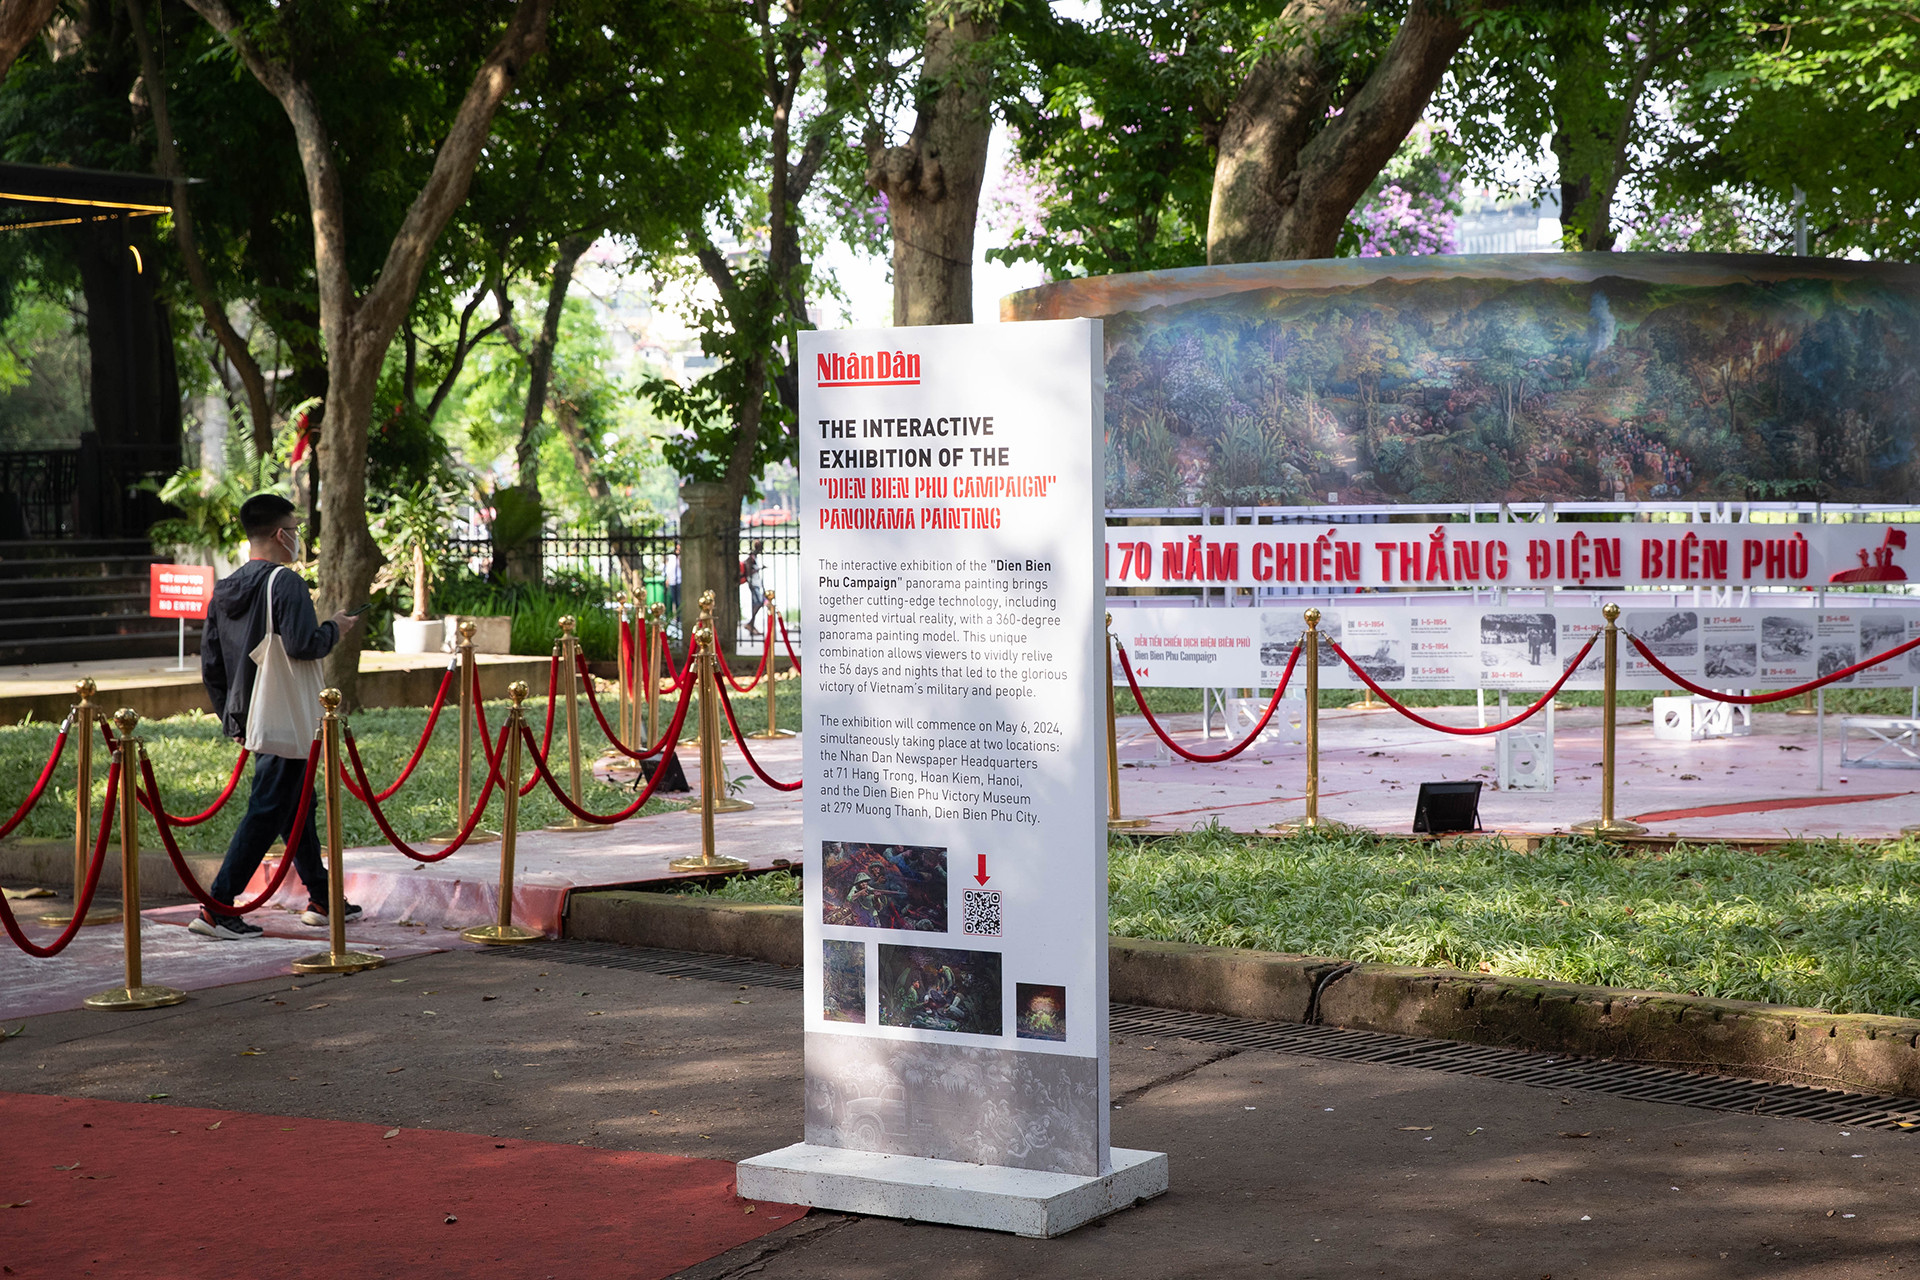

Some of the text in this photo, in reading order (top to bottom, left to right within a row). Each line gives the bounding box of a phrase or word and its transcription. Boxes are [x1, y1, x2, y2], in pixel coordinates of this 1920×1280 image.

[818, 351, 920, 380] Nhân Dân
[819, 417, 993, 438] THE INTERACTIVE
[820, 448, 1009, 468] EXHIBITION OF THE
[820, 476, 1056, 499] "DIEN BIEN PHU CAMPAIGN"
[820, 508, 1000, 529] PANORAMA PAINTING
[1118, 541, 1152, 581] 70
[1162, 535, 1238, 582] NĂM
[1252, 528, 1361, 583] CHIẾN
[1375, 525, 1508, 582] THẮNG
[1526, 531, 1622, 585] ĐIỆN
[1642, 531, 1728, 580] BIÊN
[1743, 531, 1809, 580] PHỦ
[819, 559, 1051, 571] The interactive exhibition of the "Dien Bien
[820, 577, 1048, 592] Phu Campaign" panorama painting brings
[159, 600, 202, 612] NO ENTRY
[819, 594, 1056, 611] together cutting-edge technology, including
[819, 612, 1060, 628] augmented virtual reality, with a 360-degree
[820, 631, 1027, 645] panorama painting model. This unique
[820, 646, 1052, 664] combination allows viewers to vividly relive
[1135, 650, 1217, 663] Dien Bien Phu Campaign
[820, 663, 1067, 682] the 56 days and nights that led to the glorious
[819, 681, 854, 695] victory
[857, 681, 867, 692] of
[927, 683, 969, 698] military
[972, 685, 991, 696] and
[996, 686, 1035, 699] people.
[820, 715, 1062, 735] The exhibition will commence on May 6, 2024,
[820, 733, 1059, 752] simultaneously taking place at two locations:
[821, 749, 1038, 771] the Nhan Dan Newspaper Headquarters
[823, 767, 1022, 788] at 71 Hang Trong, Hoan Kiem, Hanoi,
[821, 784, 1030, 805] and the Dien Bien Phu Victory Museum
[821, 801, 1040, 826] at 279 Muong Thanh, Dien Bien Phu City.
